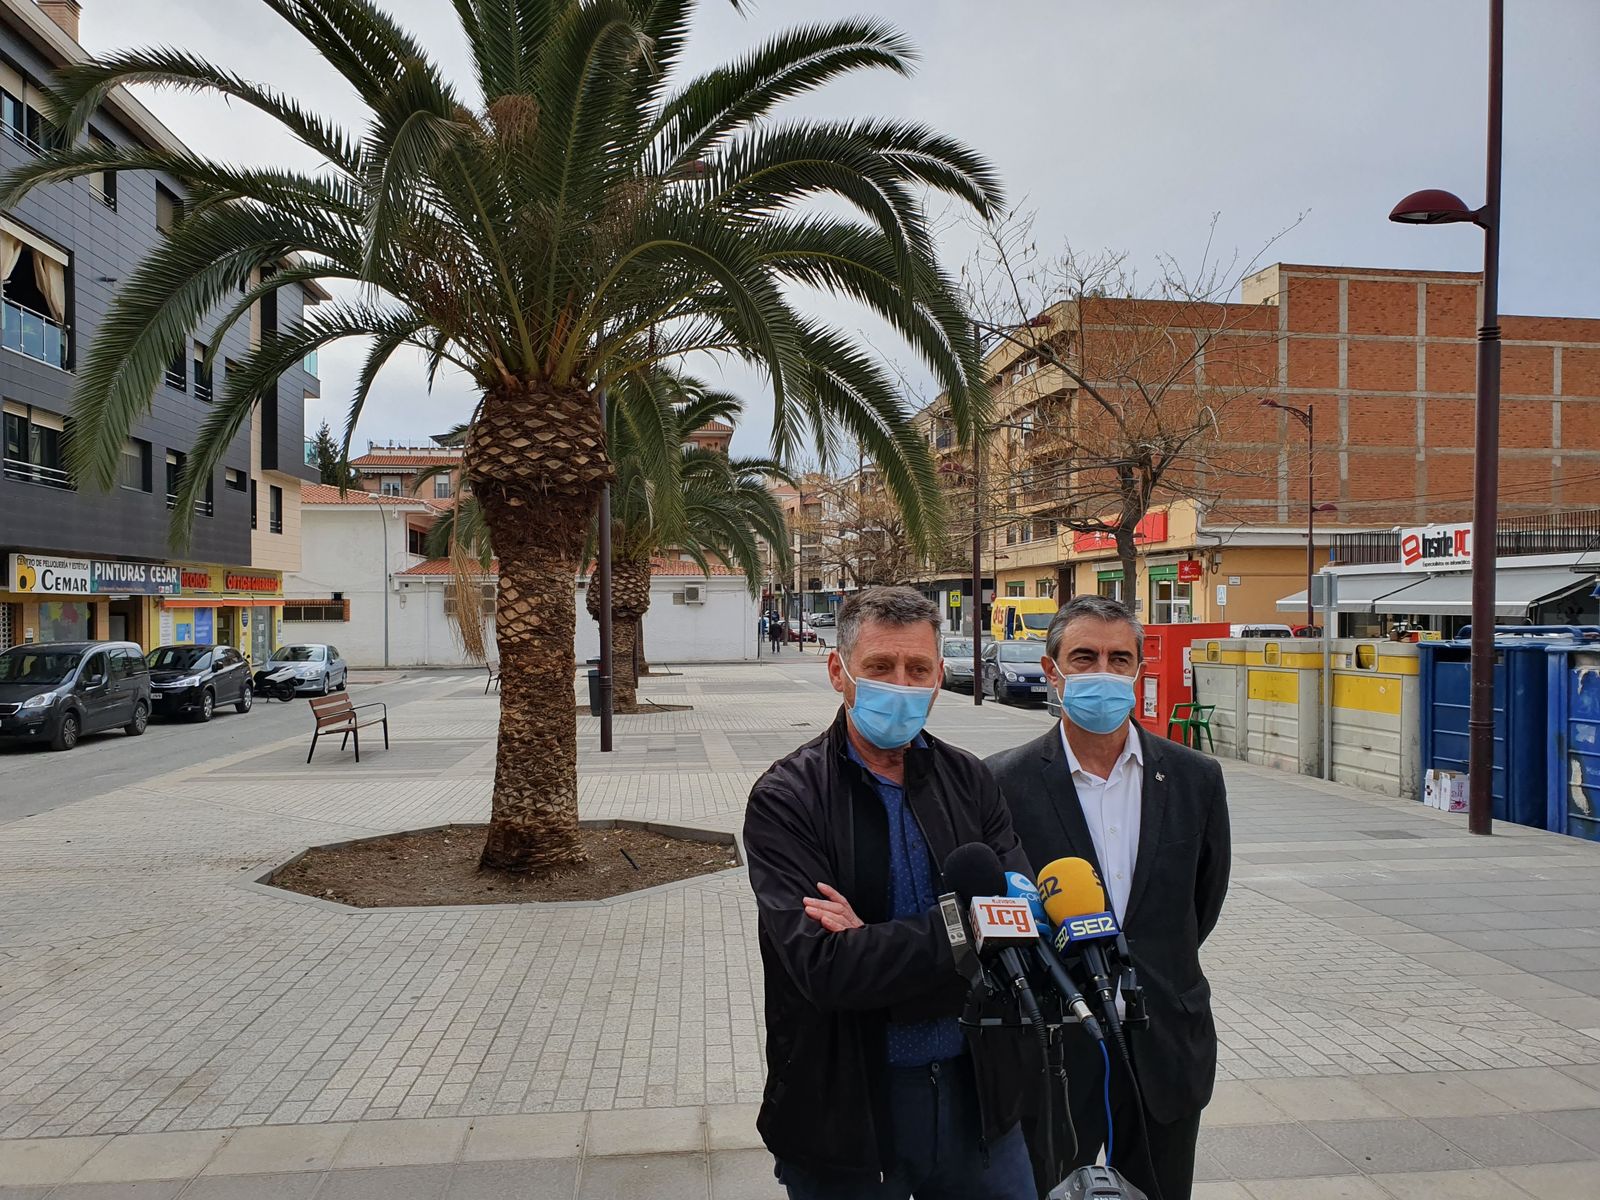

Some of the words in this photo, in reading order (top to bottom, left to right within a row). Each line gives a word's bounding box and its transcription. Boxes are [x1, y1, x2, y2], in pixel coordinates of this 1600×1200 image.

[36, 559, 42, 567] DE
[94, 562, 146, 582] PINTURAS
[150, 566, 177, 583] CESAR
[1070, 916, 1116, 937] SER
